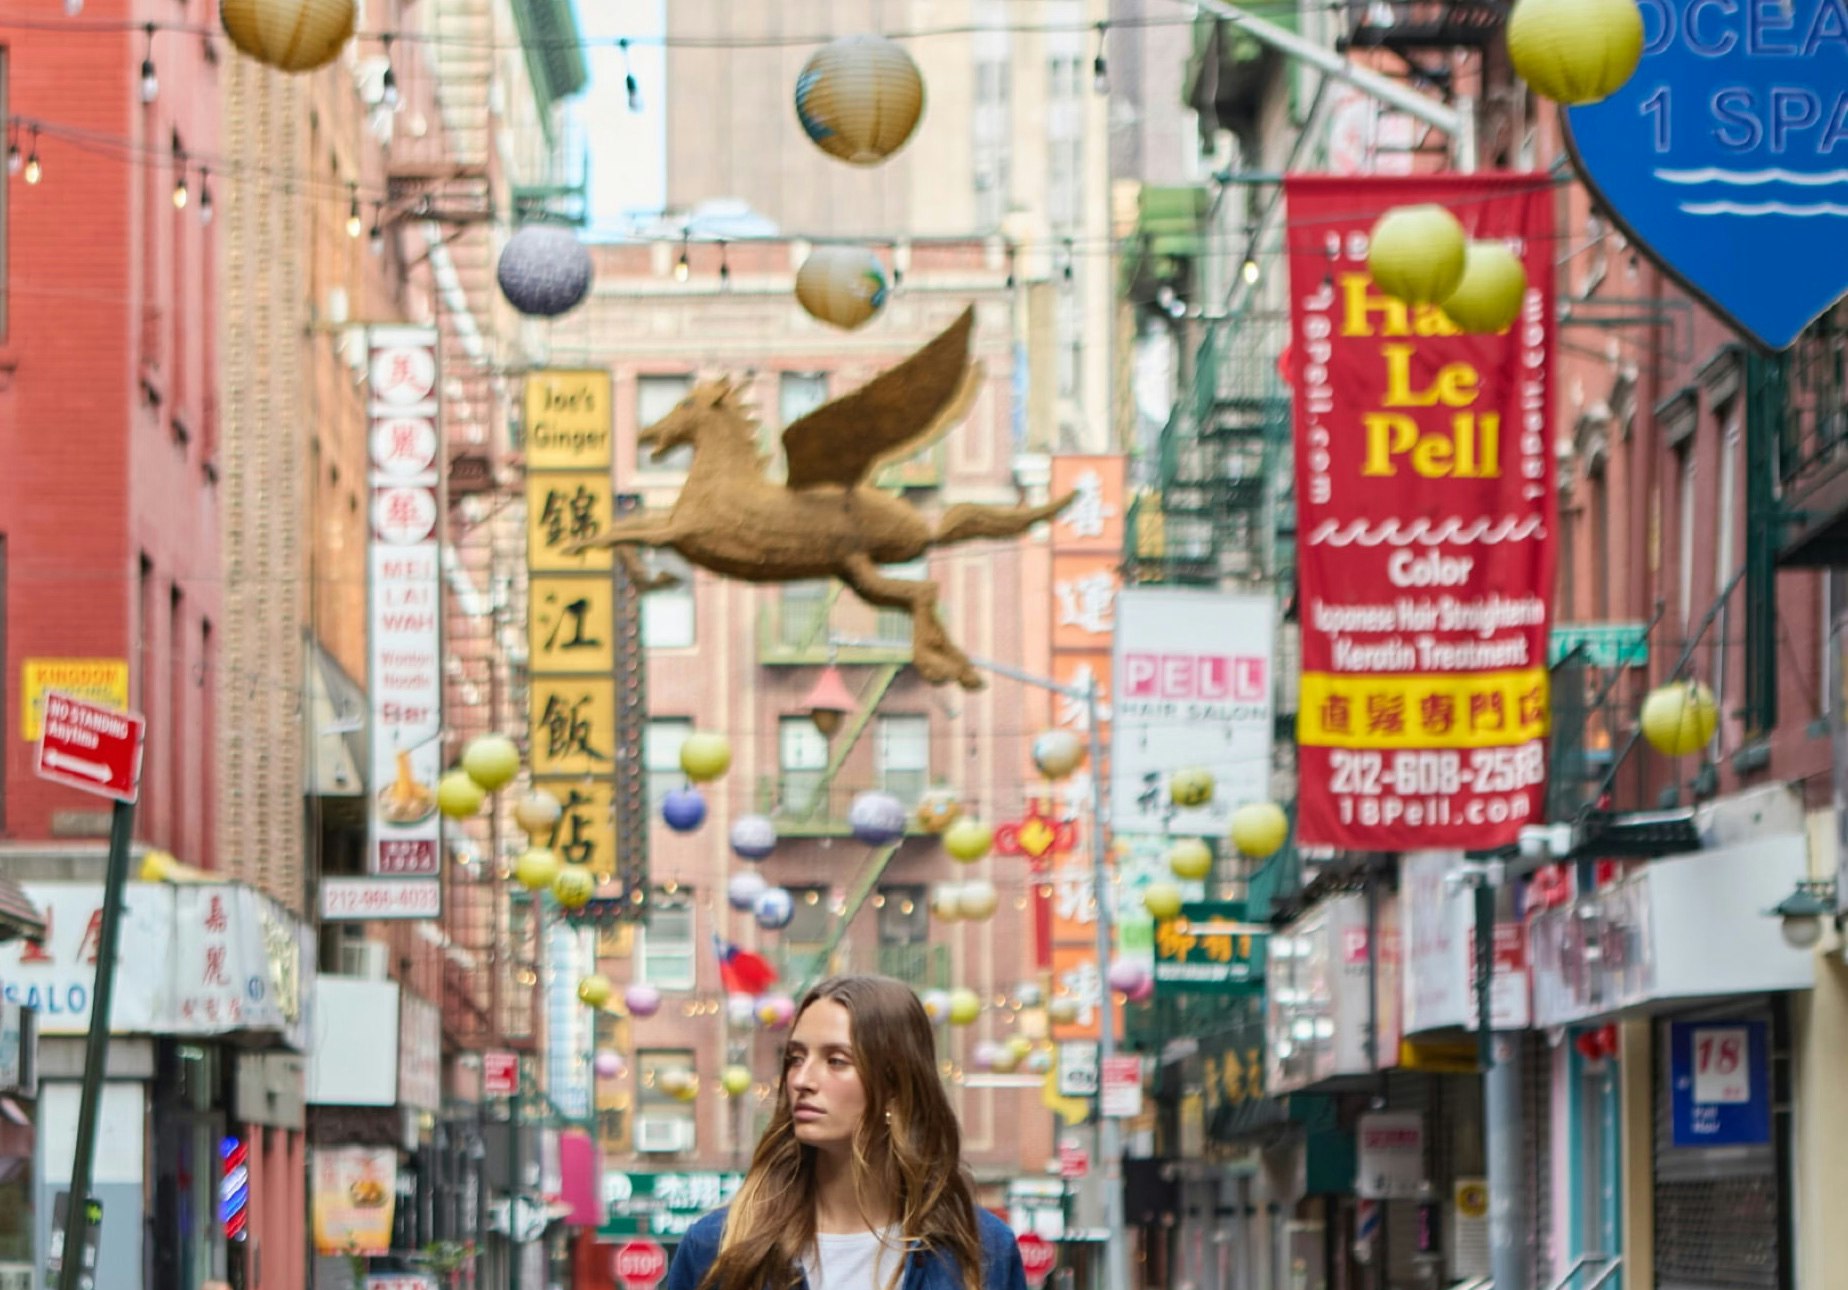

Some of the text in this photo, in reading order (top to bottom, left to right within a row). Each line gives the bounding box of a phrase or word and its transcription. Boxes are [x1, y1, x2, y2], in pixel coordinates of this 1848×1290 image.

[1640, 86, 1672, 153] 1
[1340, 271, 1512, 337] Ha
[1381, 341, 1479, 408] Le
[544, 386, 595, 412] Joe's
[533, 421, 608, 454] Ginger
[1361, 411, 1502, 479] Pell
[383, 560, 432, 580] MEI
[1388, 549, 1473, 588] Color
[383, 613, 434, 632] WAH
[1331, 635, 1416, 672] Keratin
[1415, 632, 1530, 671] Treatment
[1126, 656, 1265, 697] PELL
[49, 721, 99, 750] Anytime
[50, 701, 70, 722] NO
[70, 704, 129, 740] STANDING
[3, 984, 89, 1013] SALO
[1697, 1036, 1741, 1076] 18
[619, 1255, 665, 1277] STOP
